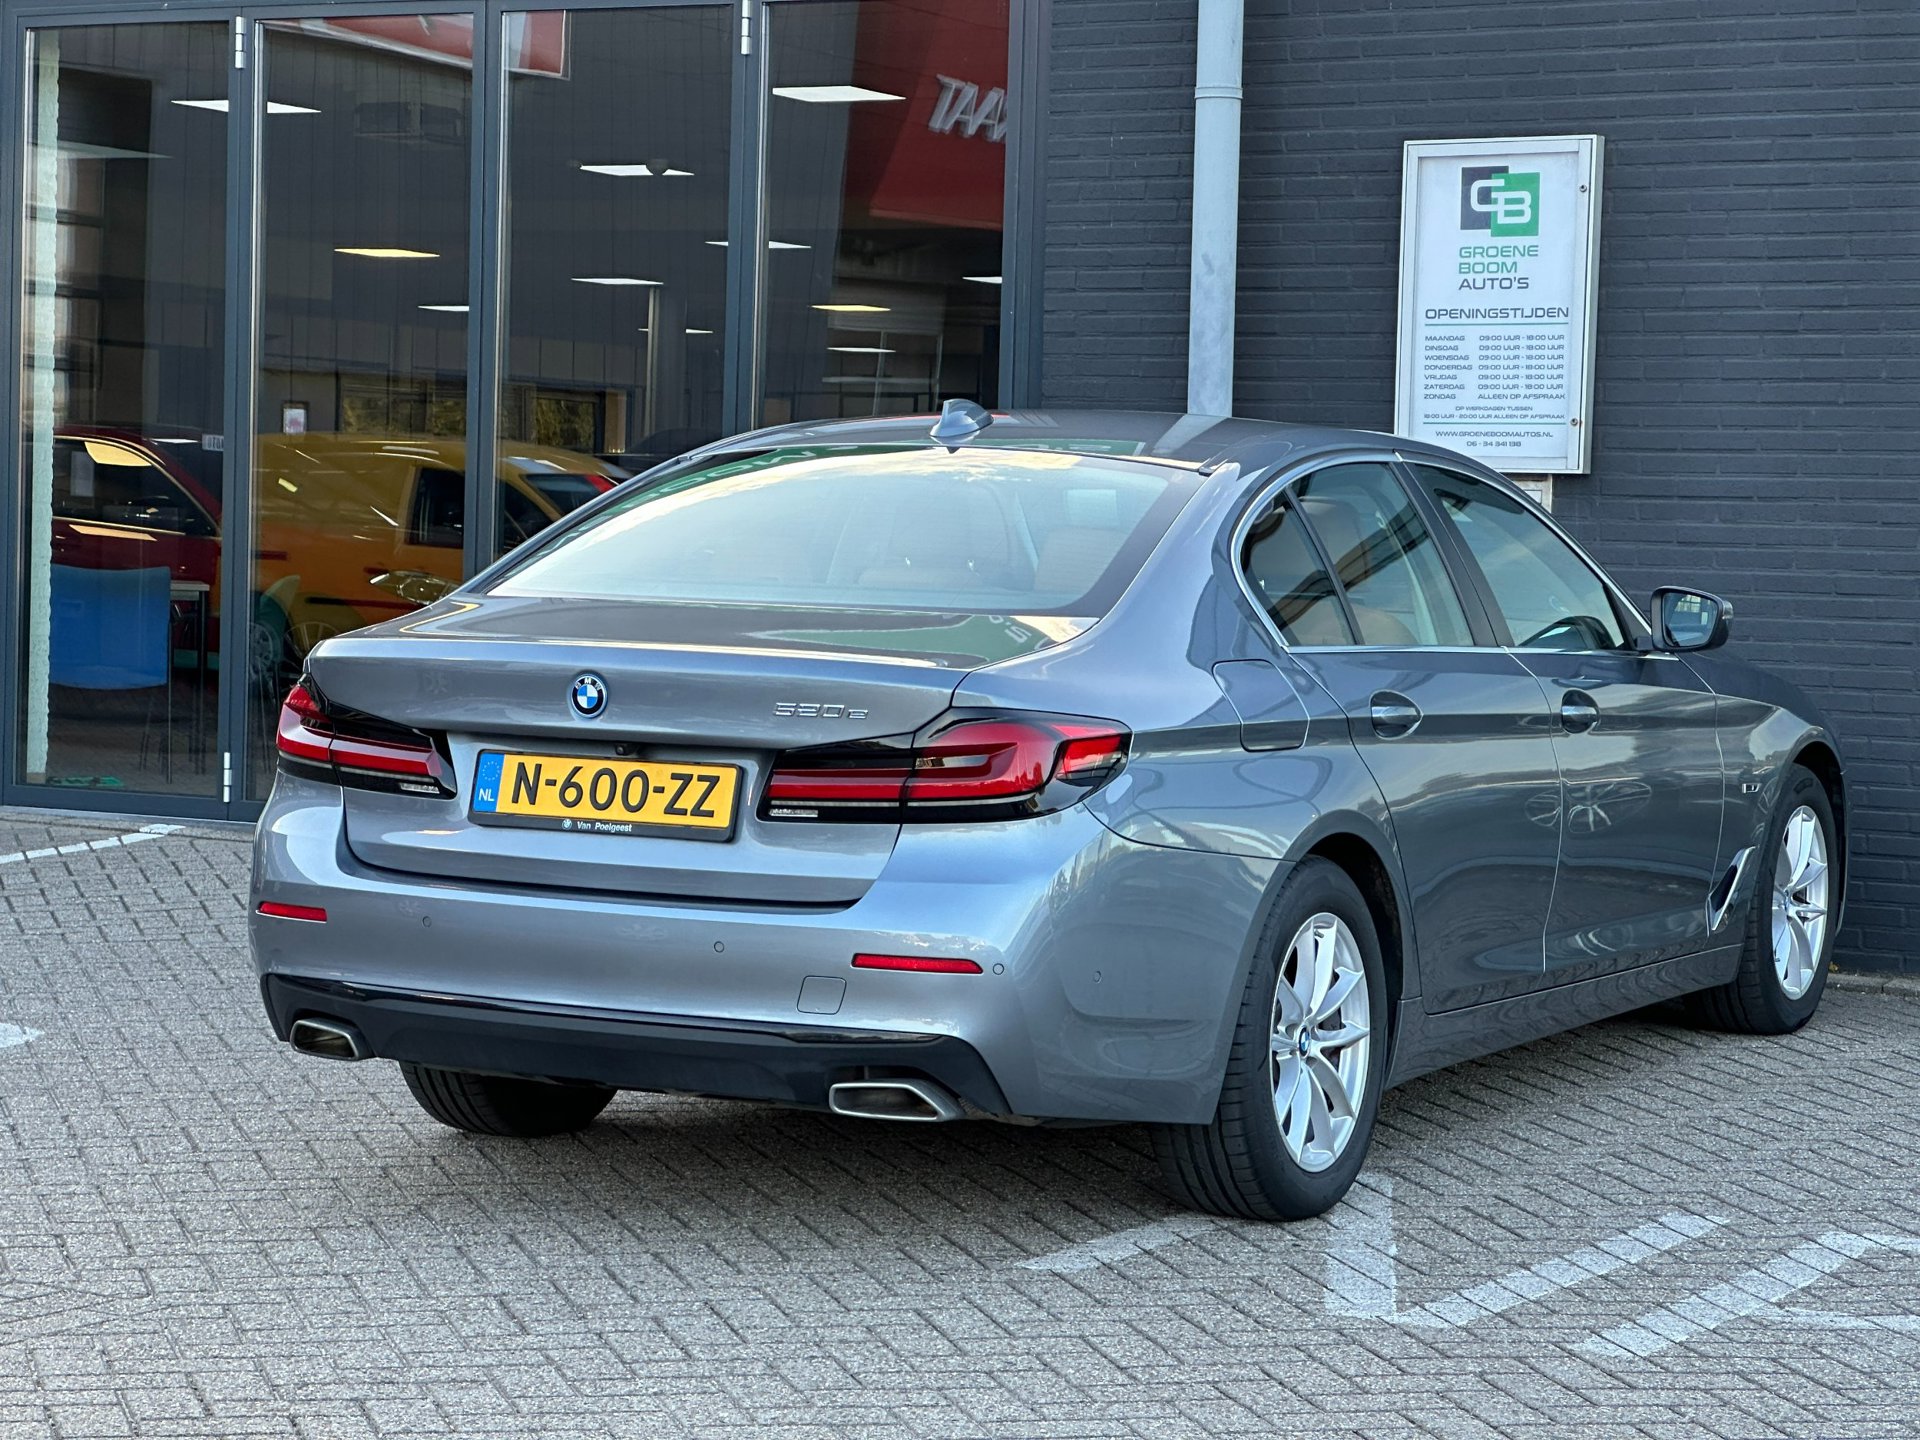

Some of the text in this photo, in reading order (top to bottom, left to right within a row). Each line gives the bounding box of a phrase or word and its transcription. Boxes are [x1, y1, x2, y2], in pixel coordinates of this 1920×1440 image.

[1459, 245, 1539, 259] GROENE
[1458, 261, 1517, 274] BOOM
[1458, 277, 1529, 290] AUTO'S
[1425, 307, 1569, 319] OPENINGSTIJDEN
[478, 788, 494, 802] NL
[511, 762, 720, 818] N-600-ZZ
[577, 821, 632, 833] Van Poelgeest
